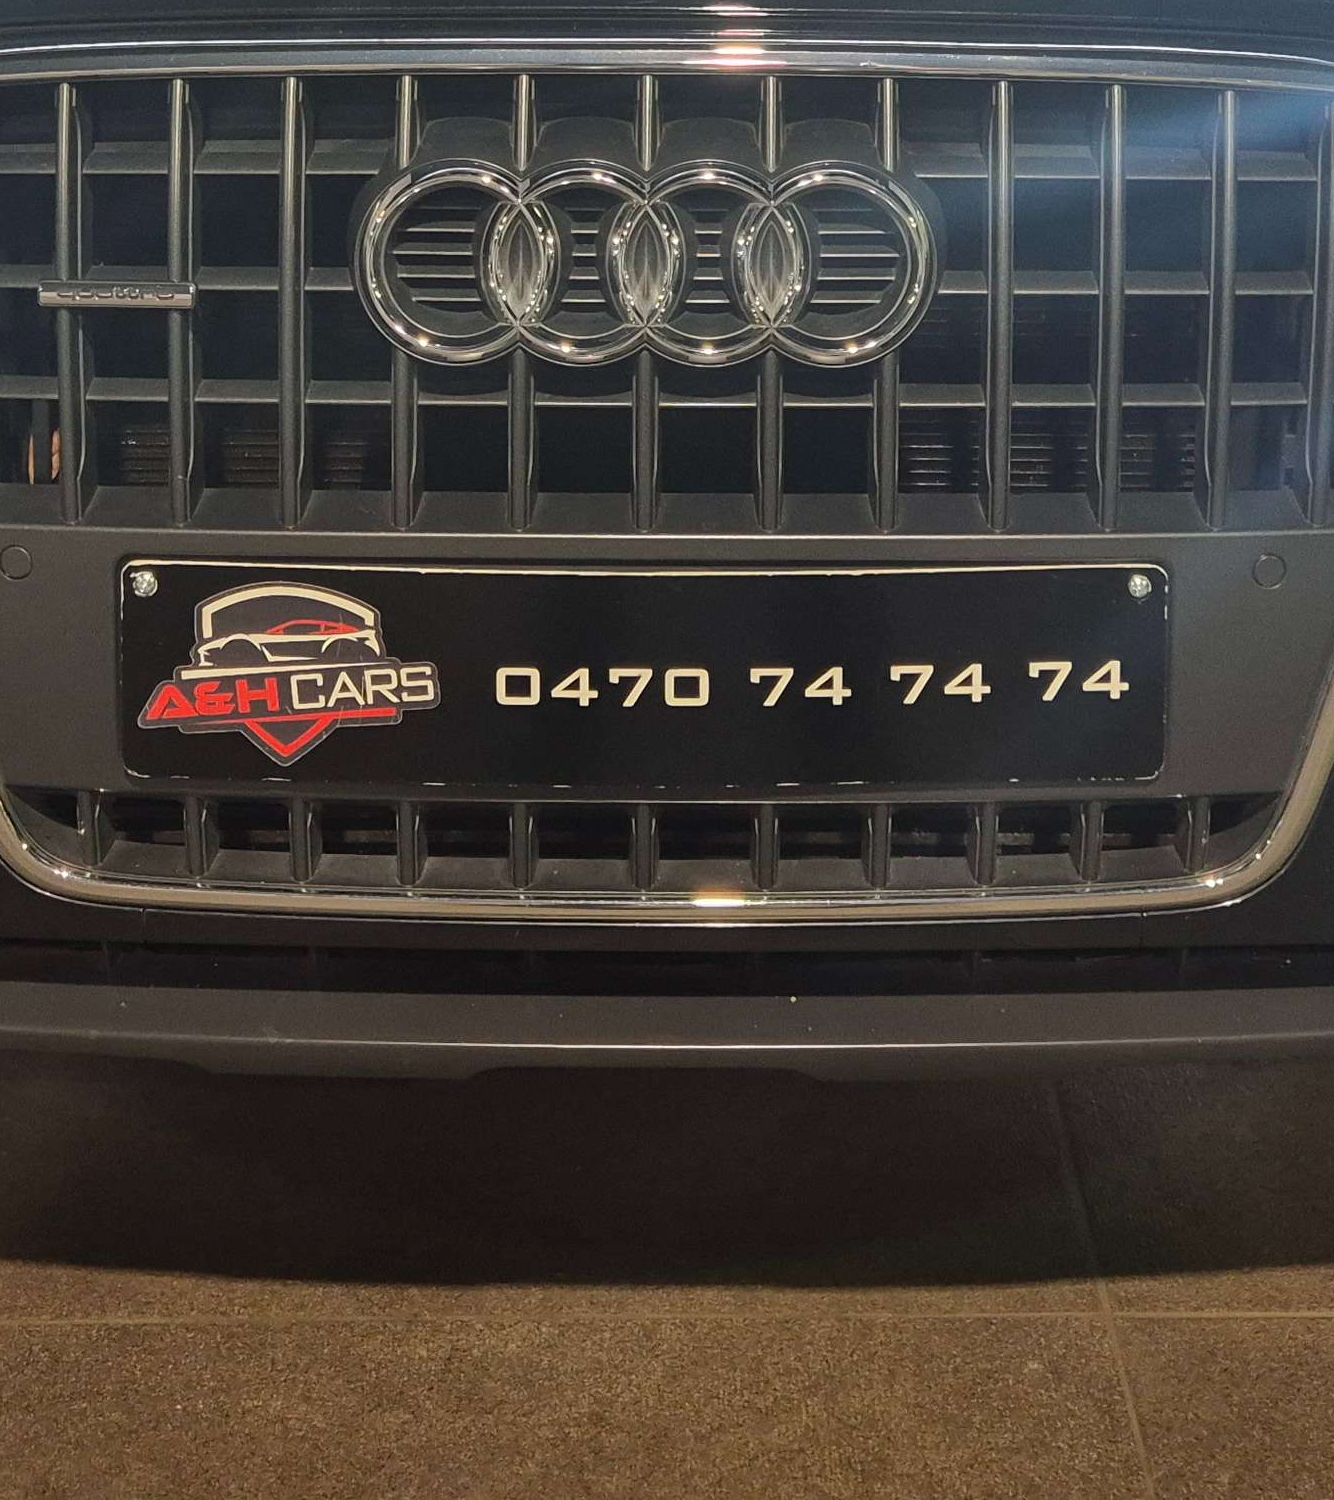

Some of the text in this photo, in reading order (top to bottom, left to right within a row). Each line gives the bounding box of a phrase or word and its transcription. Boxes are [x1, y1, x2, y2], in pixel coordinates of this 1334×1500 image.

[146, 666, 435, 720] A&H CARS
[495, 659, 1130, 708] 0470 74 74 74
